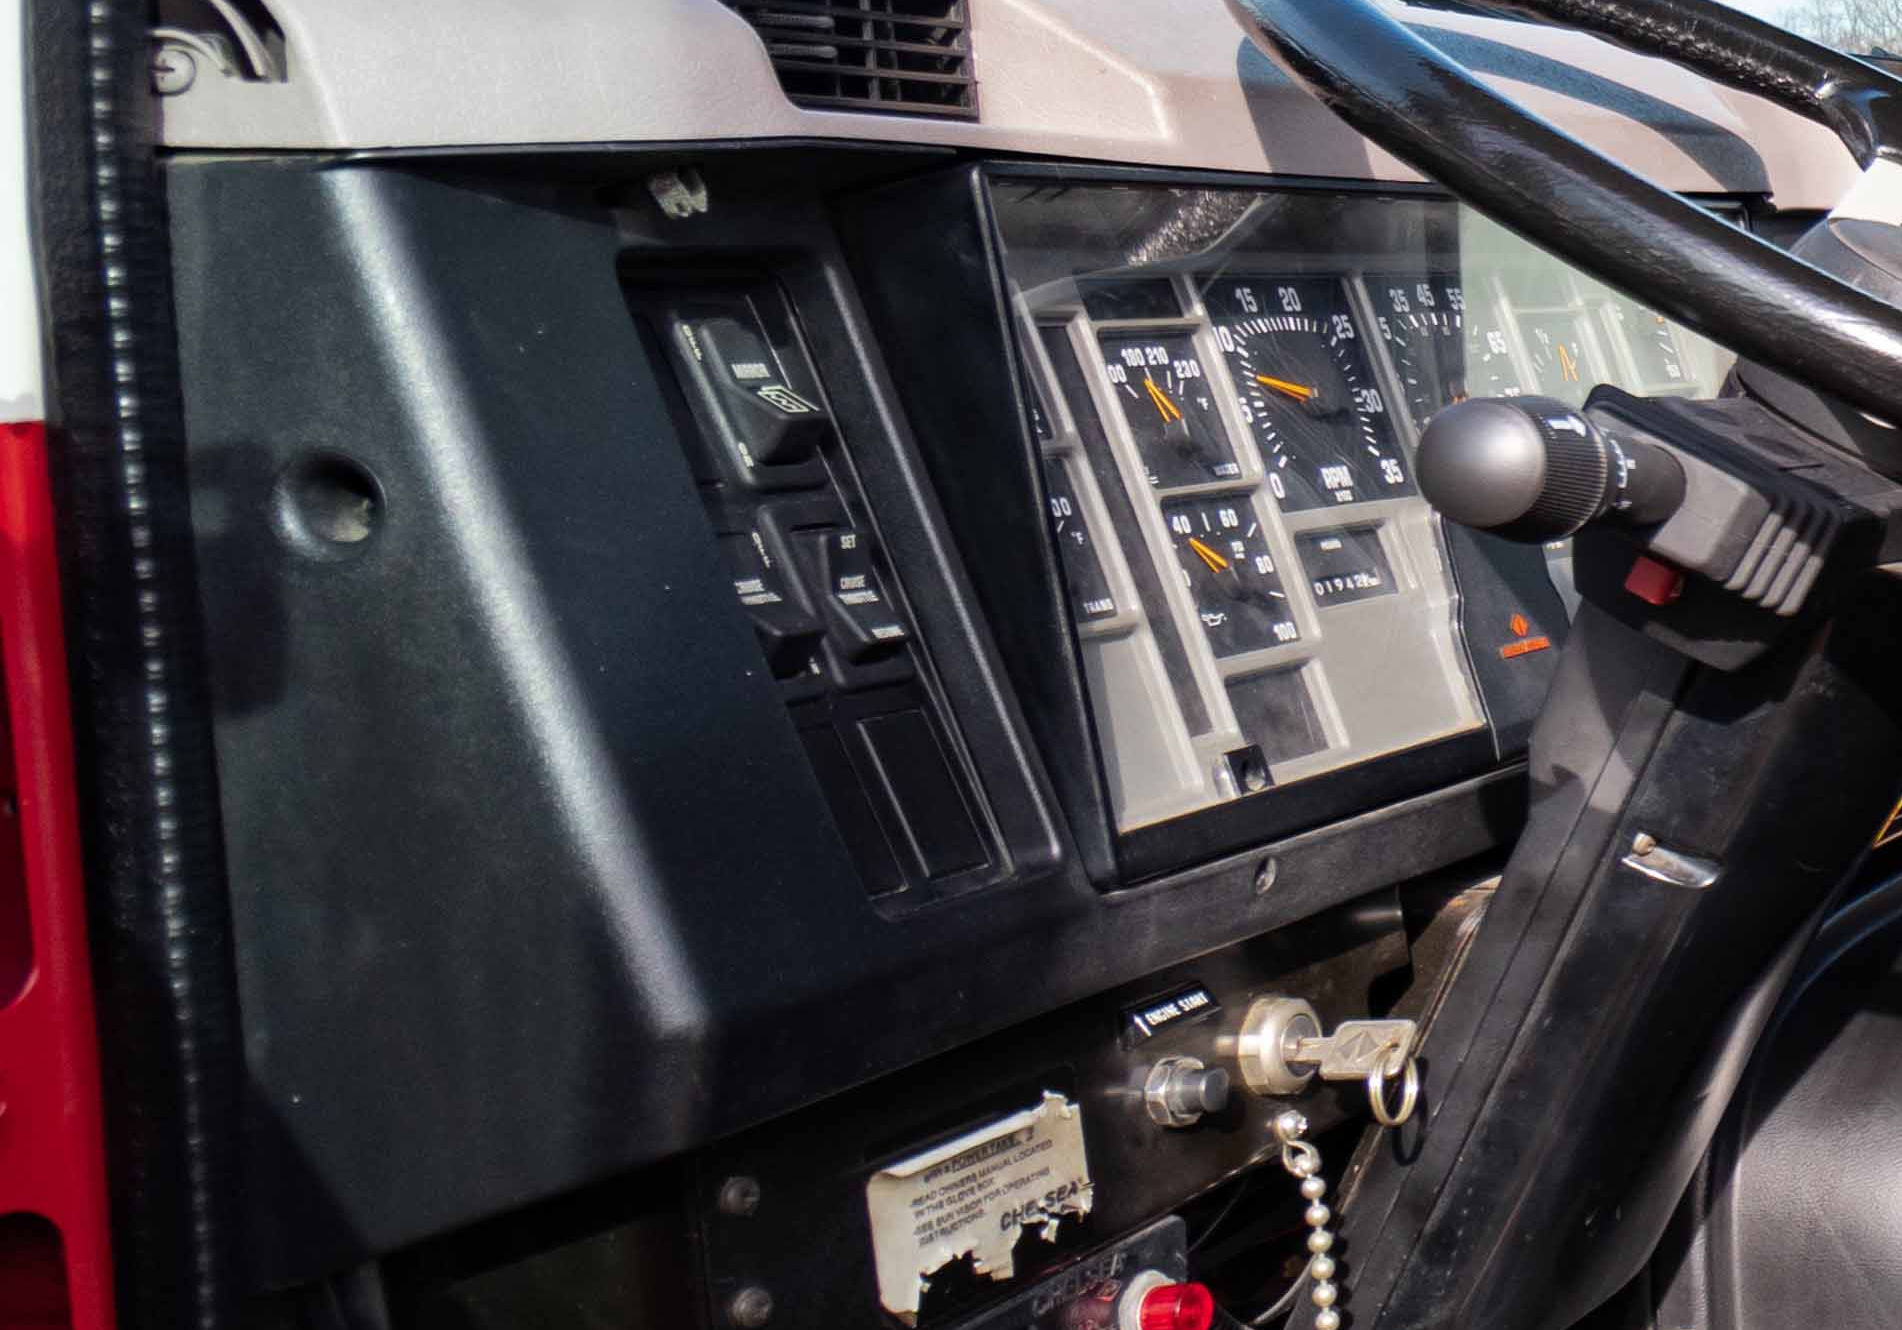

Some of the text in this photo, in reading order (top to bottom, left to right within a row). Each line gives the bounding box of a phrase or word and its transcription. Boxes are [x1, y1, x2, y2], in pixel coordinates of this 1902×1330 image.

[1235, 287, 1259, 314] 15
[1278, 286, 1302, 312] 20
[1416, 284, 1435, 310] 45
[1446, 288, 1466, 311] 55
[1212, 325, 1236, 353] 10
[1332, 314, 1355, 340] 25
[1173, 359, 1201, 379] 230
[1361, 388, 1385, 414] 30
[1319, 464, 1354, 490] RPM
[1380, 458, 1404, 484] 35
[1269, 472, 1286, 499] 0
[1172, 515, 1192, 535] 40
[1144, 991, 1209, 1026] ENGINE START
